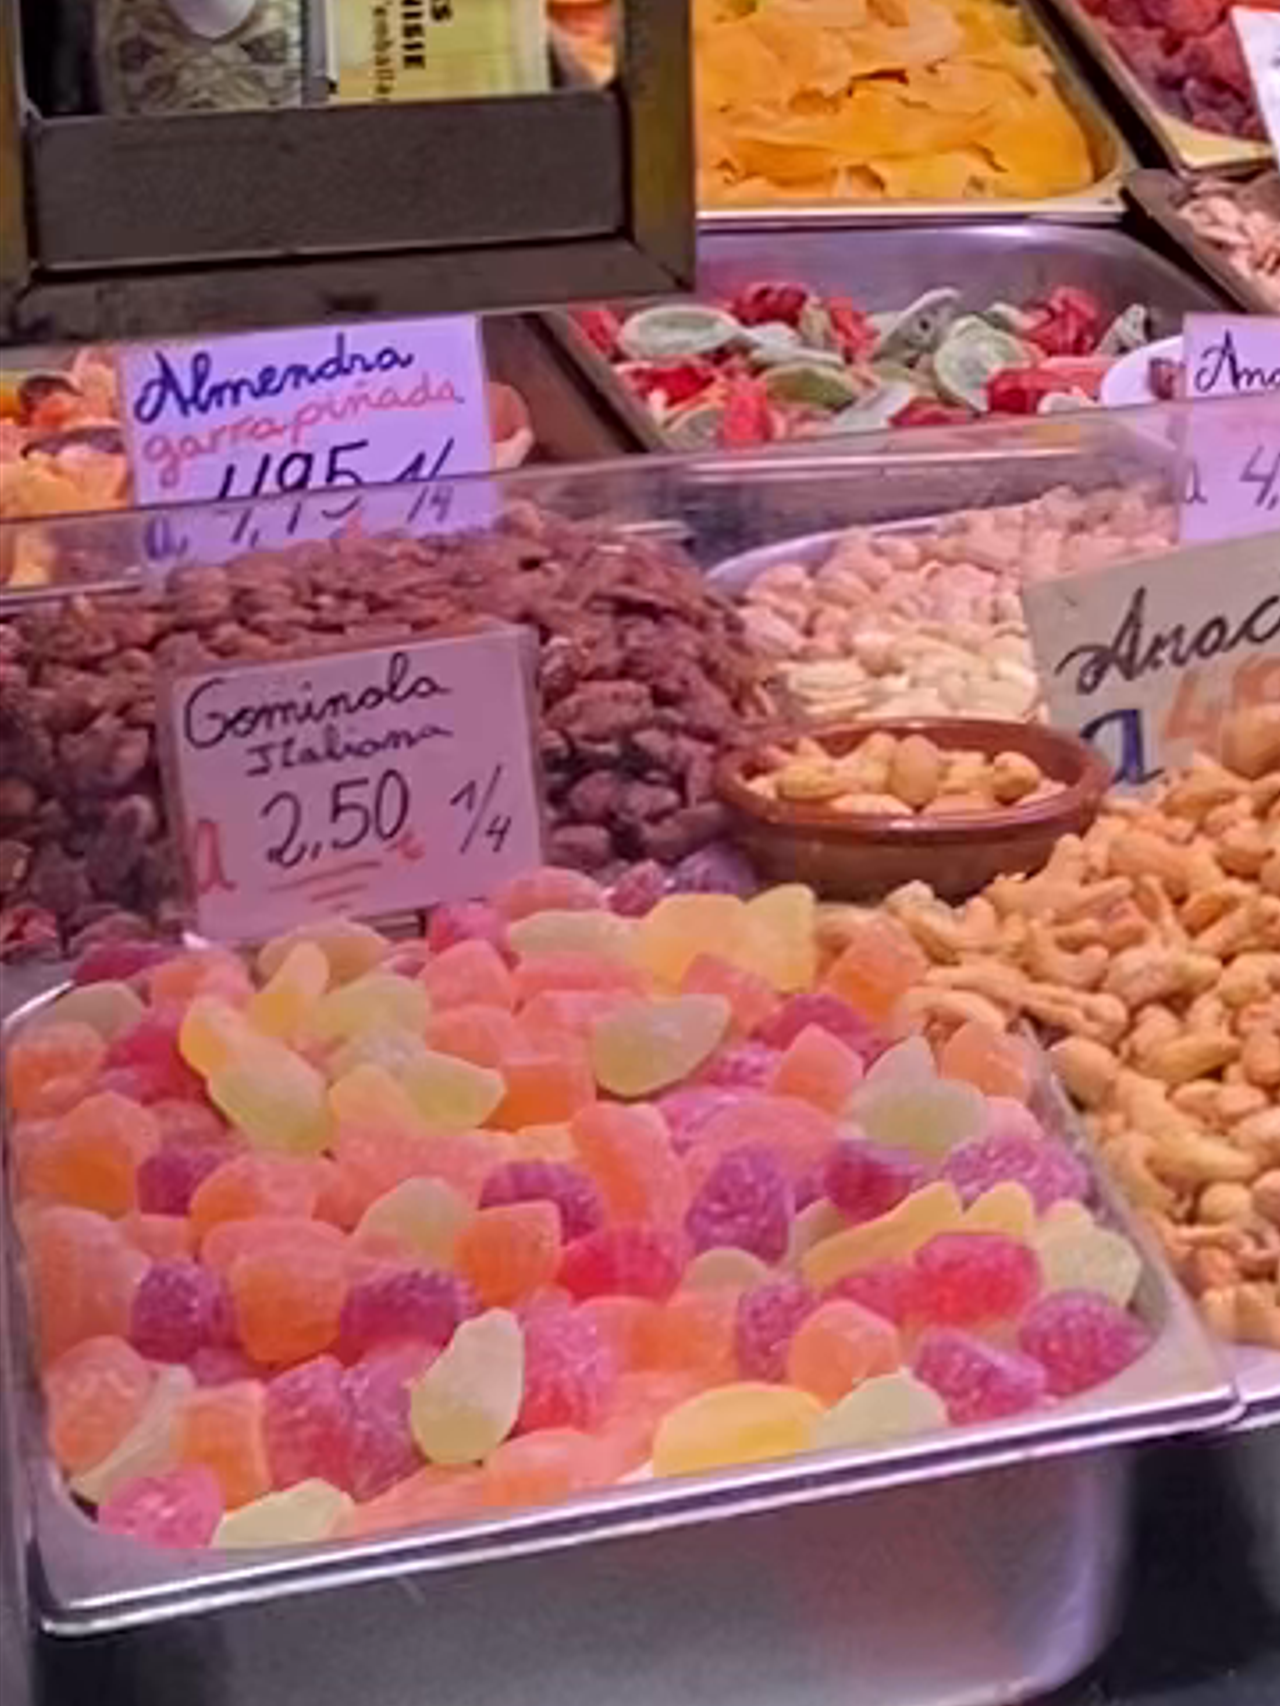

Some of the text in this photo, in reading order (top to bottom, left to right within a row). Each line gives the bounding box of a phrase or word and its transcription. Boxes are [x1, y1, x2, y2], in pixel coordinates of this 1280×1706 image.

[134, 332, 415, 424] Almendra
[142, 372, 466, 489] garrapiñada
[259, 768, 411, 869] 2,50
[449, 763, 514, 856] 1/4
